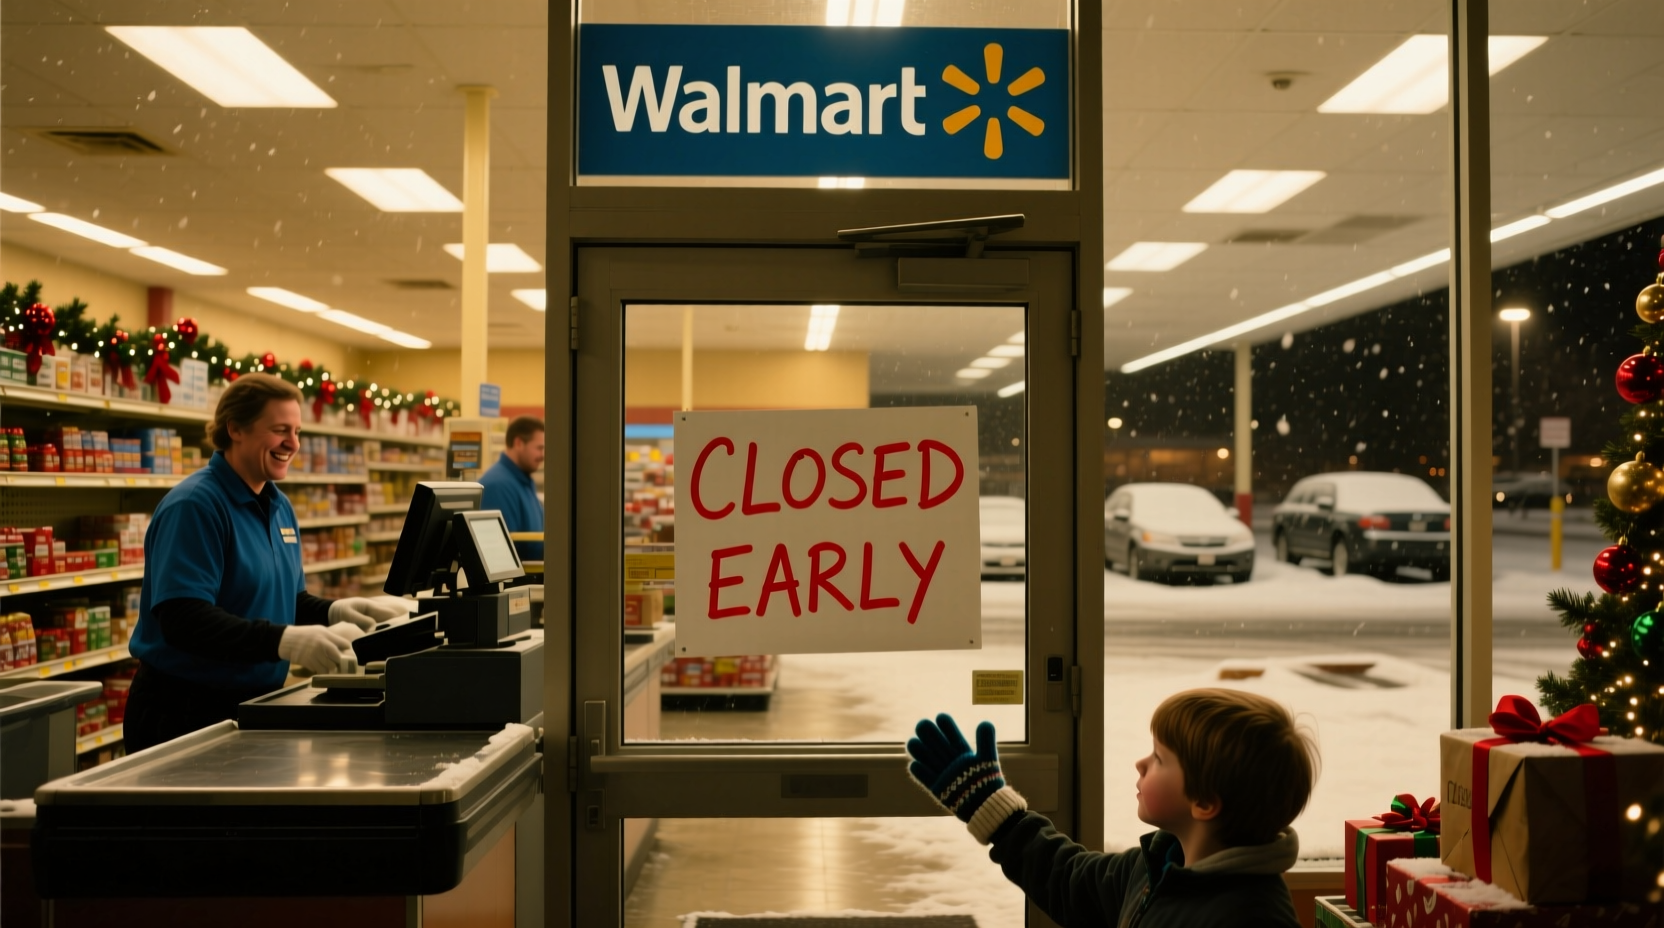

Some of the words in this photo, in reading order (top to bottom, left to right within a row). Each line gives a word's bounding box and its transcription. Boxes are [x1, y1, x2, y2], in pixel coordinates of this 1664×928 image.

[602, 64, 927, 136] Walmart
[690, 436, 965, 521] CLOSED
[707, 540, 946, 625] EARLY
